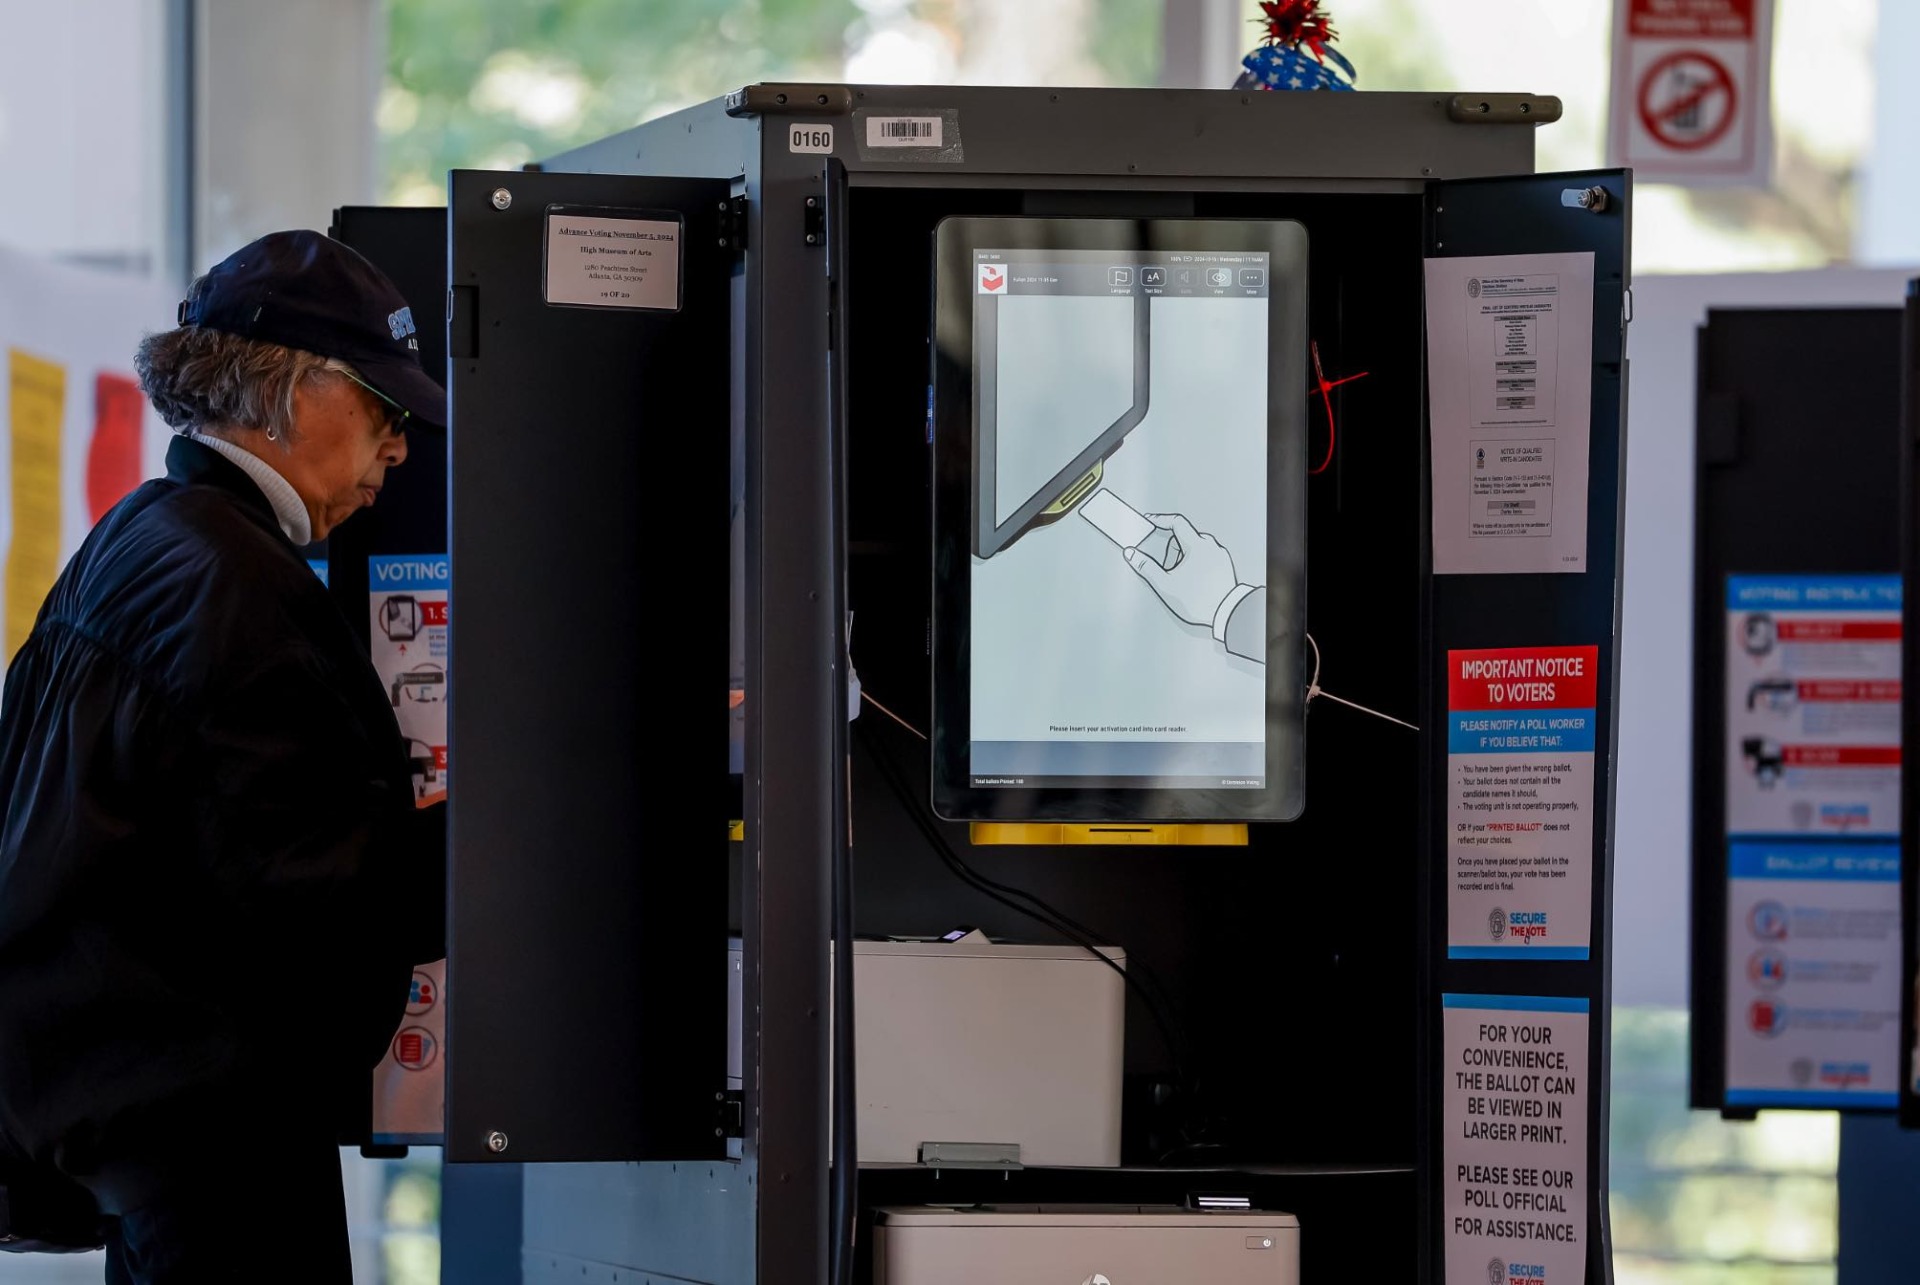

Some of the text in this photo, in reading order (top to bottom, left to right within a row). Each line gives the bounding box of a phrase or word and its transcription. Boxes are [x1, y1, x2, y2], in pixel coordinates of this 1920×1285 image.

[793, 131, 830, 148] 0160
[589, 229, 611, 238] Voting
[613, 231, 647, 239] November
[650, 233, 655, 241] 5,
[581, 246, 597, 254] High
[599, 247, 628, 255] Museum
[376, 562, 448, 581] VOTING
[428, 607, 438, 619] 1.
[1462, 658, 1583, 679] IMPORTANT NOTICE
[1488, 683, 1555, 703] TO VOTERS
[1461, 718, 1585, 731] PLEASE NOTIFY A POLL WORKER
[1480, 736, 1562, 748] IF YOU BELIEVE THAT:
[1464, 765, 1473, 773] You
[1475, 764, 1488, 772] have
[1505, 765, 1521, 774] given
[1522, 764, 1531, 772] the
[1533, 765, 1552, 774] wrong
[1553, 764, 1572, 772] ballot,
[1494, 777, 1508, 785] does
[1520, 777, 1541, 785] contain
[1463, 790, 1490, 798] candidate
[1463, 802, 1473, 810] The
[1474, 803, 1492, 812] voting
[1494, 802, 1504, 810] unit
[1506, 802, 1510, 810] is
[1512, 802, 1521, 810] not
[1523, 802, 1550, 811] operating
[1544, 823, 1558, 831] does
[1458, 836, 1475, 844] reflect
[1490, 836, 1512, 844] choices.
[1473, 859, 1483, 867] you
[1500, 857, 1518, 866] placed
[1534, 857, 1550, 865] ballot
[1458, 870, 1496, 878] scanner/ballot
[1498, 870, 1509, 879] box,
[1539, 870, 1549, 878] has
[1510, 912, 1546, 924] SECURE
[1510, 927, 1525, 936] THE
[1480, 1024, 1552, 1044] FOR YOUR
[1463, 1048, 1568, 1072] CONVENIENCE,
[1456, 1072, 1575, 1095] THE BALLOT CAN
[1468, 1097, 1561, 1119] BE VIEWED IN
[1464, 1121, 1566, 1144] LARGER PRINT.
[1458, 1165, 1573, 1189] PLEASE SEE OUR
[1465, 1189, 1566, 1213] POLL OFFICIAL
[1455, 1217, 1577, 1243] FOR ASSISTANCE.
[1509, 1263, 1544, 1277] SECURE
